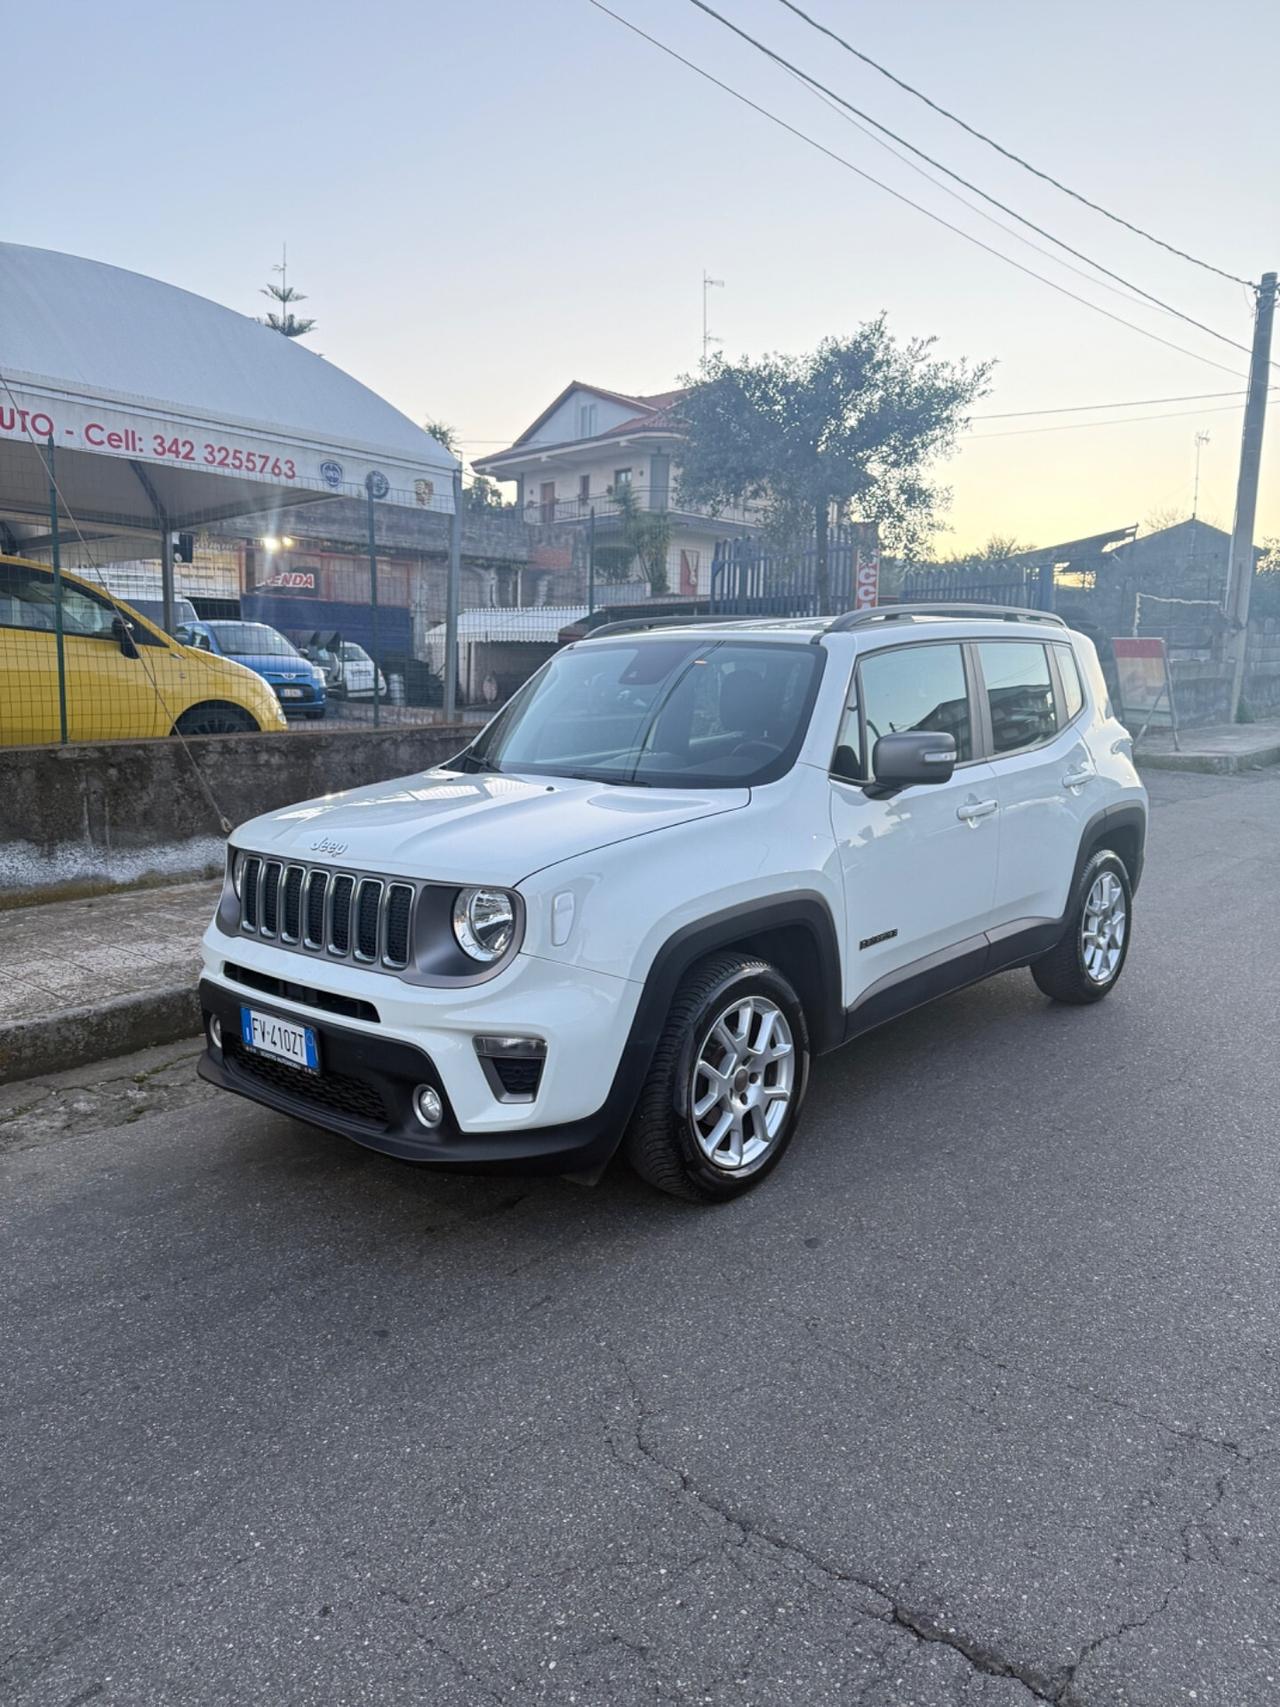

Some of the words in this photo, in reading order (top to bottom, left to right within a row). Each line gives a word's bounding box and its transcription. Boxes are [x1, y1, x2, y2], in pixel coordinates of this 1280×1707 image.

[84, 423, 143, 453] Cell:
[153, 434, 195, 461] 342
[203, 443, 296, 480] 3255763
[310, 836, 349, 858] Jeep
